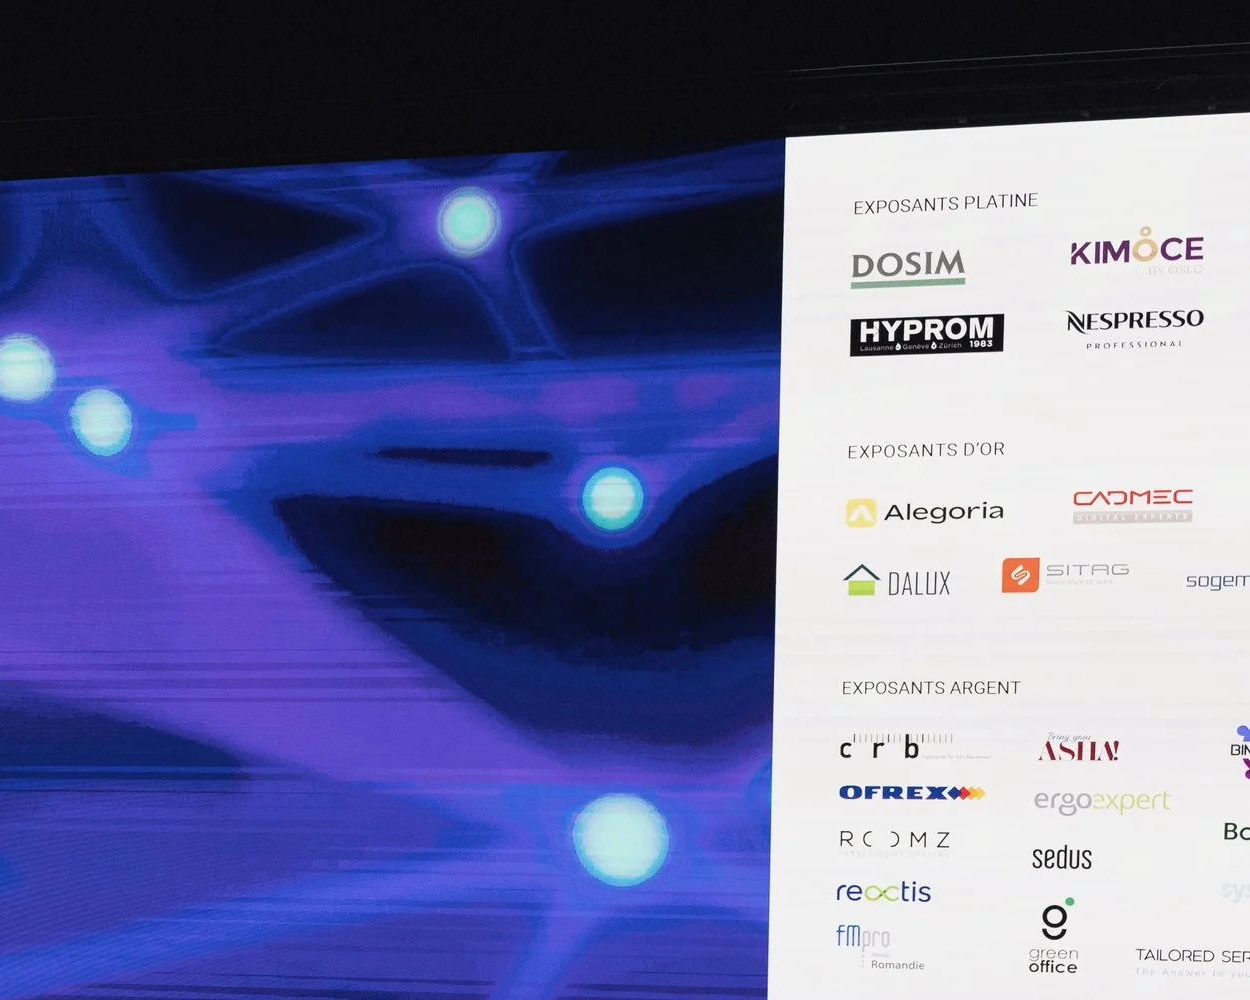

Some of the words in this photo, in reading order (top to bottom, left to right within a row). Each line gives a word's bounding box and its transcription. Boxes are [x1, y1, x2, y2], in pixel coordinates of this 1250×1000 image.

[854, 197, 959, 216] EXPOSANTS
[964, 192, 1038, 210] PLATINE
[1071, 231, 1204, 265] KIMOCE
[851, 249, 966, 278] DOSIM
[860, 317, 994, 343] HYPROM
[1063, 309, 1205, 335] NESPRESSO
[969, 340, 994, 348] 1983
[1086, 340, 1183, 350] PROFESSIONAL
[848, 443, 957, 459] EXPOSANTS
[963, 442, 1005, 457] D'OR
[1073, 489, 1194, 506] CADMEC
[884, 501, 1004, 524] Alegoria
[1077, 513, 1126, 522] DIGITAL
[1046, 563, 1130, 577] SITAG
[888, 571, 950, 596] DALUX
[842, 681, 945, 695] EXPOSANTS
[950, 680, 1021, 695] ARGENT
[1038, 740, 1120, 761] ASHA!
[839, 785, 948, 800] OFREX
[1034, 791, 1171, 816] ergoexpert
[1032, 844, 1092, 870] sedus
[1029, 948, 1079, 961] green
[1136, 948, 1215, 962] TAILORED
[871, 960, 925, 970] Romandie
[1029, 961, 1078, 974] office
[1136, 967, 1155, 976] The
[1163, 968, 1206, 977] Answer
